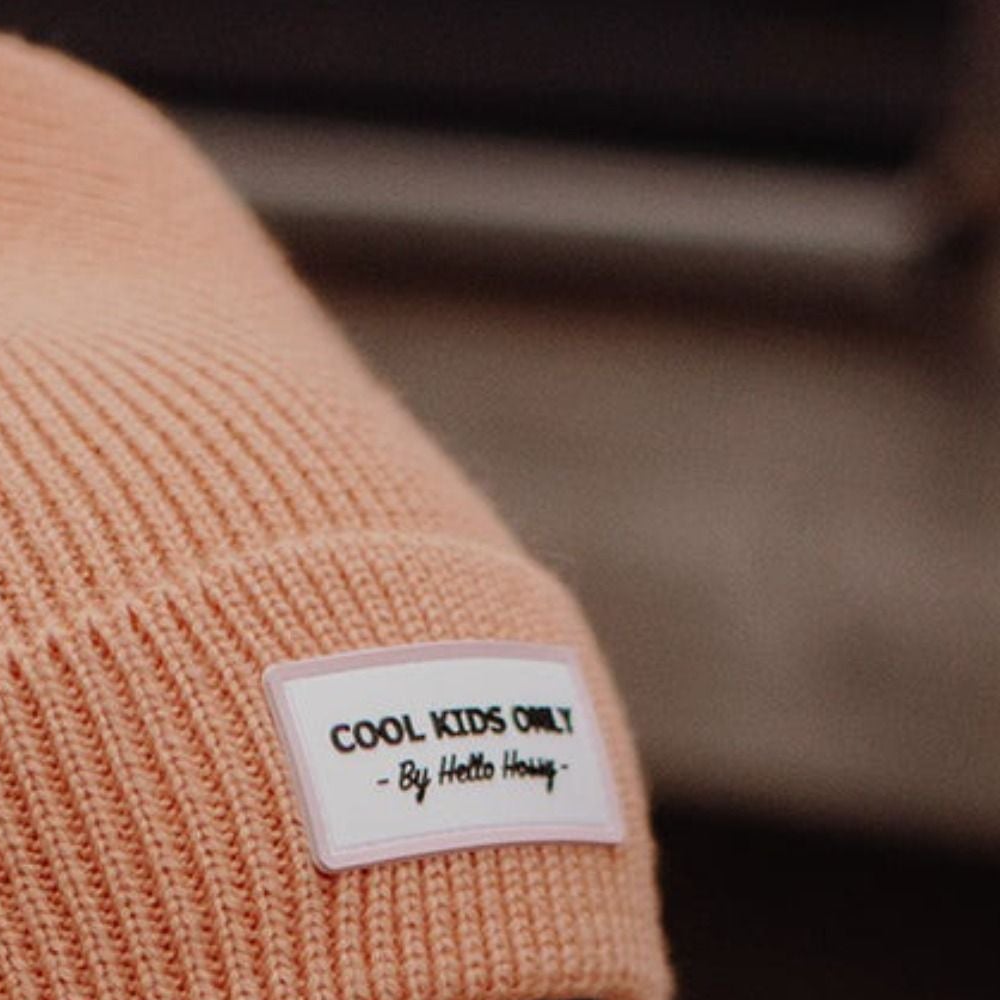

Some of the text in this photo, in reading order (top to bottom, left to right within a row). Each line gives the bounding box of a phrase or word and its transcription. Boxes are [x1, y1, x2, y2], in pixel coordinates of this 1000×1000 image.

[330, 714, 426, 754] COOL
[429, 705, 507, 740] KIDS
[398, 759, 432, 804] By
[438, 752, 495, 785] Hello
